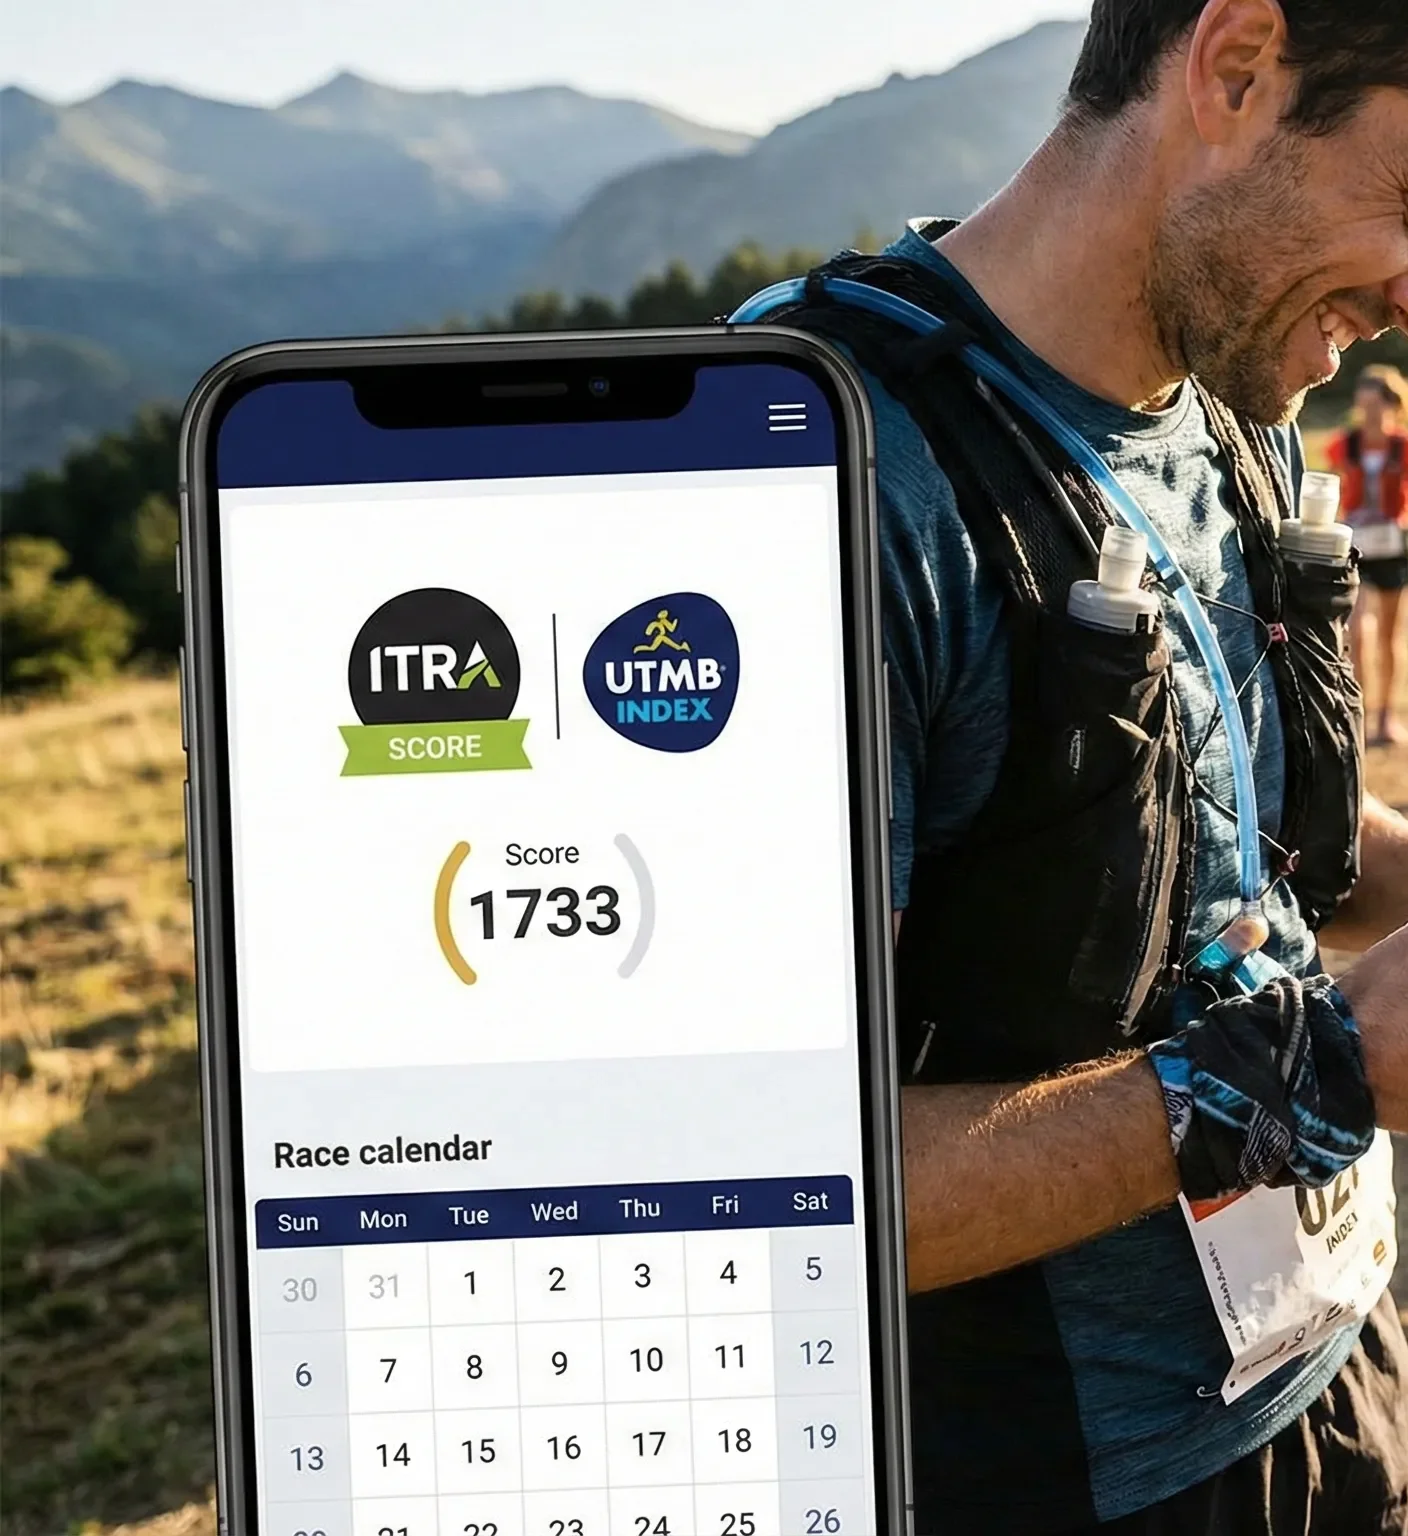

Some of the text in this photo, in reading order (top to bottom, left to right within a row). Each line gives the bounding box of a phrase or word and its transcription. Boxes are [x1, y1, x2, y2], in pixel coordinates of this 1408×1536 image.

[370, 642, 500, 691] ITRA
[618, 698, 712, 723] INDEX
[389, 735, 481, 760] SCORE
[506, 843, 579, 866] Score
[471, 885, 620, 939] 1733
[275, 1134, 492, 1168] Race calendar
[279, 1193, 828, 1231] Sun Mon Tue Wed Thu Fri Sat
[283, 1257, 821, 1302] 30 31 1 2 3 4 5
[296, 1340, 834, 1387] 6 7 8 9 10 11 12
[291, 1424, 836, 1471] 13 14 15 16 17 18 19
[635, 1516, 670, 1536] 24
[721, 1513, 755, 1536] 25
[806, 1509, 840, 1534] 26
